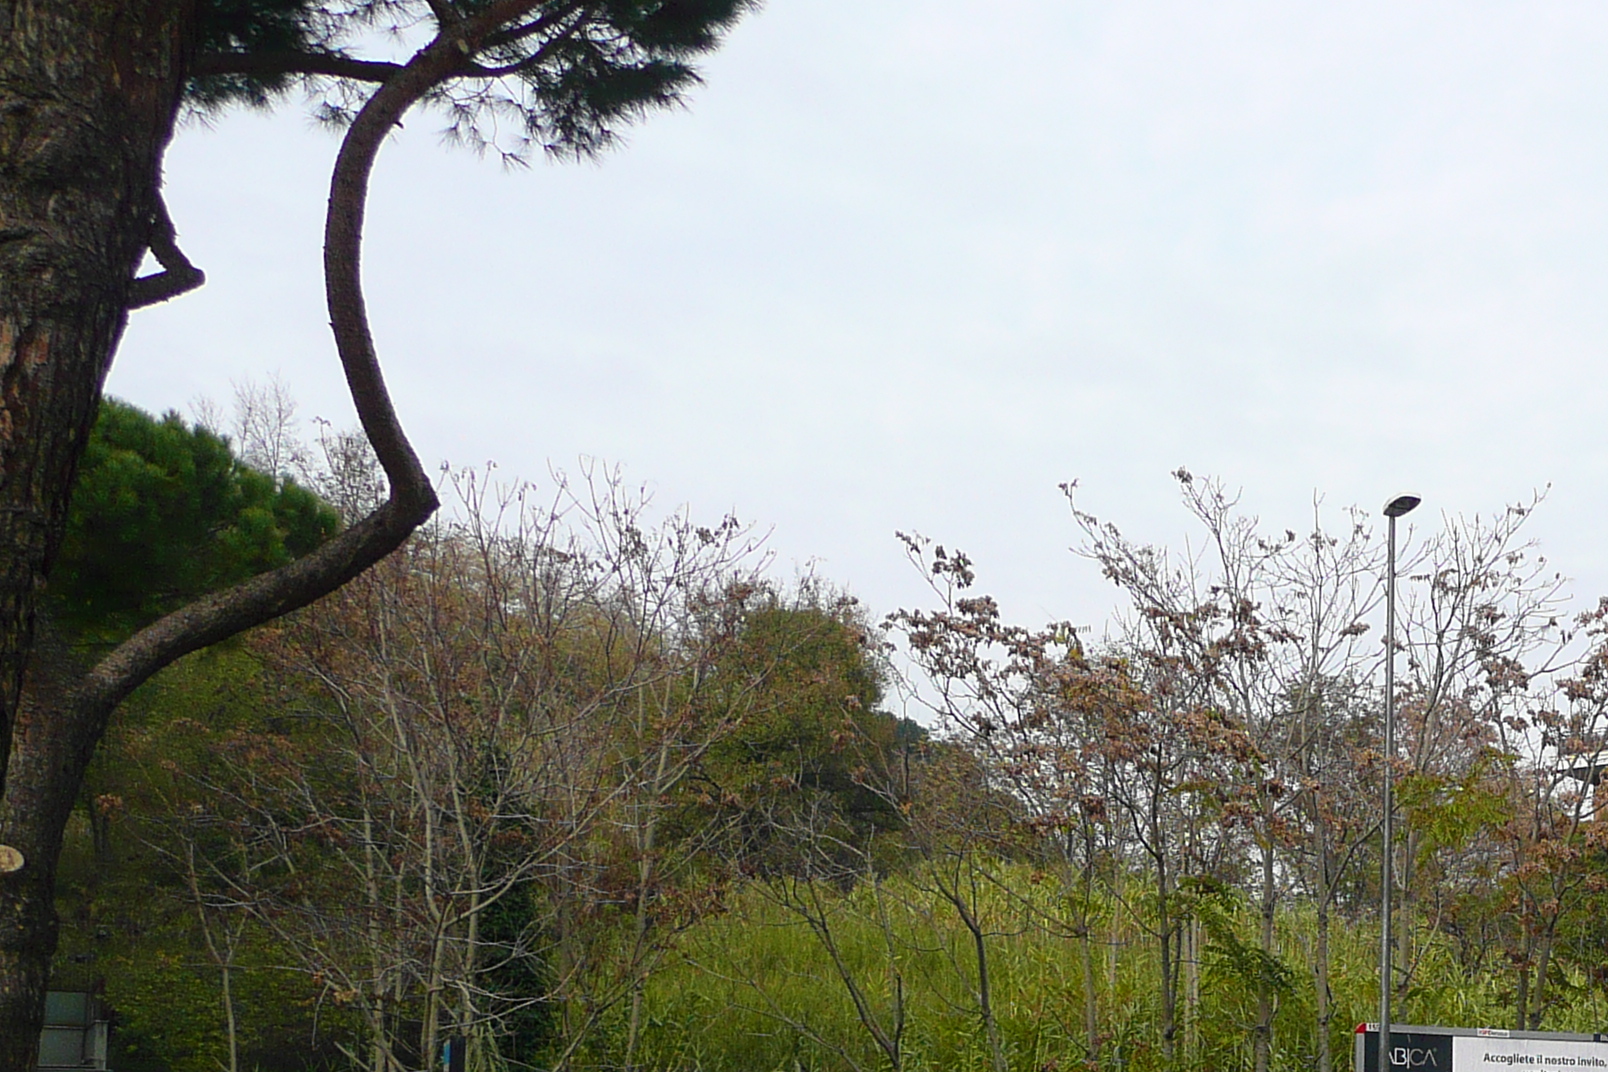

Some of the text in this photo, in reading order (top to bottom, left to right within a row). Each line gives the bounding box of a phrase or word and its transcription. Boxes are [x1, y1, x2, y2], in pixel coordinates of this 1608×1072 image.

[1388, 1047, 1438, 1069] BICA
[1483, 1053, 1608, 1068] Accogliete il nostro invito,
